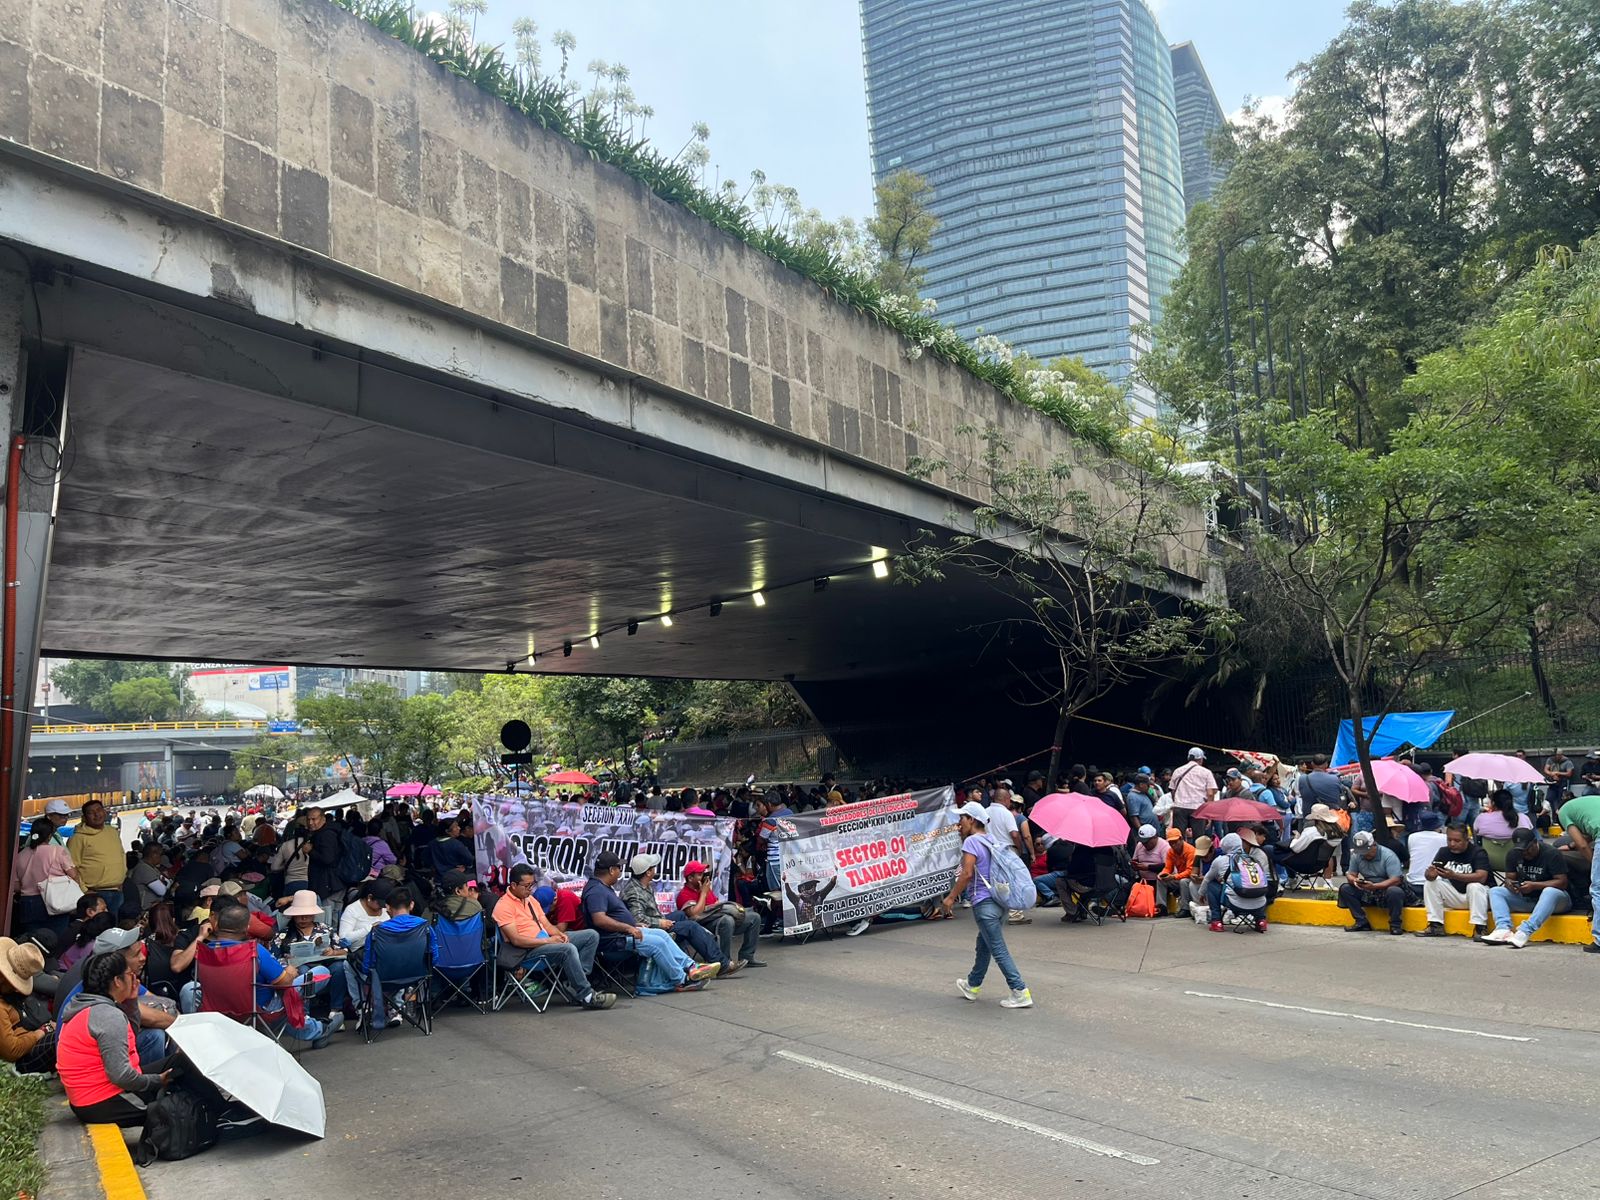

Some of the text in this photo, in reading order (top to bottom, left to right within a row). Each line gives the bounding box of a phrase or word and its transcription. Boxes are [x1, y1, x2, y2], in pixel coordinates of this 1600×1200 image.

[582, 805, 634, 825] SECCION XXII
[820, 810, 867, 826] TRABAJADORES
[869, 808, 877, 817] DE
[878, 806, 885, 815] LA
[838, 811, 916, 834] SECCION XXII OAXACA
[510, 835, 588, 877] SECTOR
[785, 858, 796, 869] NO
[836, 836, 907, 868] SECTOR 01
[845, 857, 908, 889] TLAXIACO
[836, 901, 846, 910] LA
[892, 882, 917, 895] SERVICIO
[918, 878, 928, 888] DEL
[868, 905, 874, 914] Y
